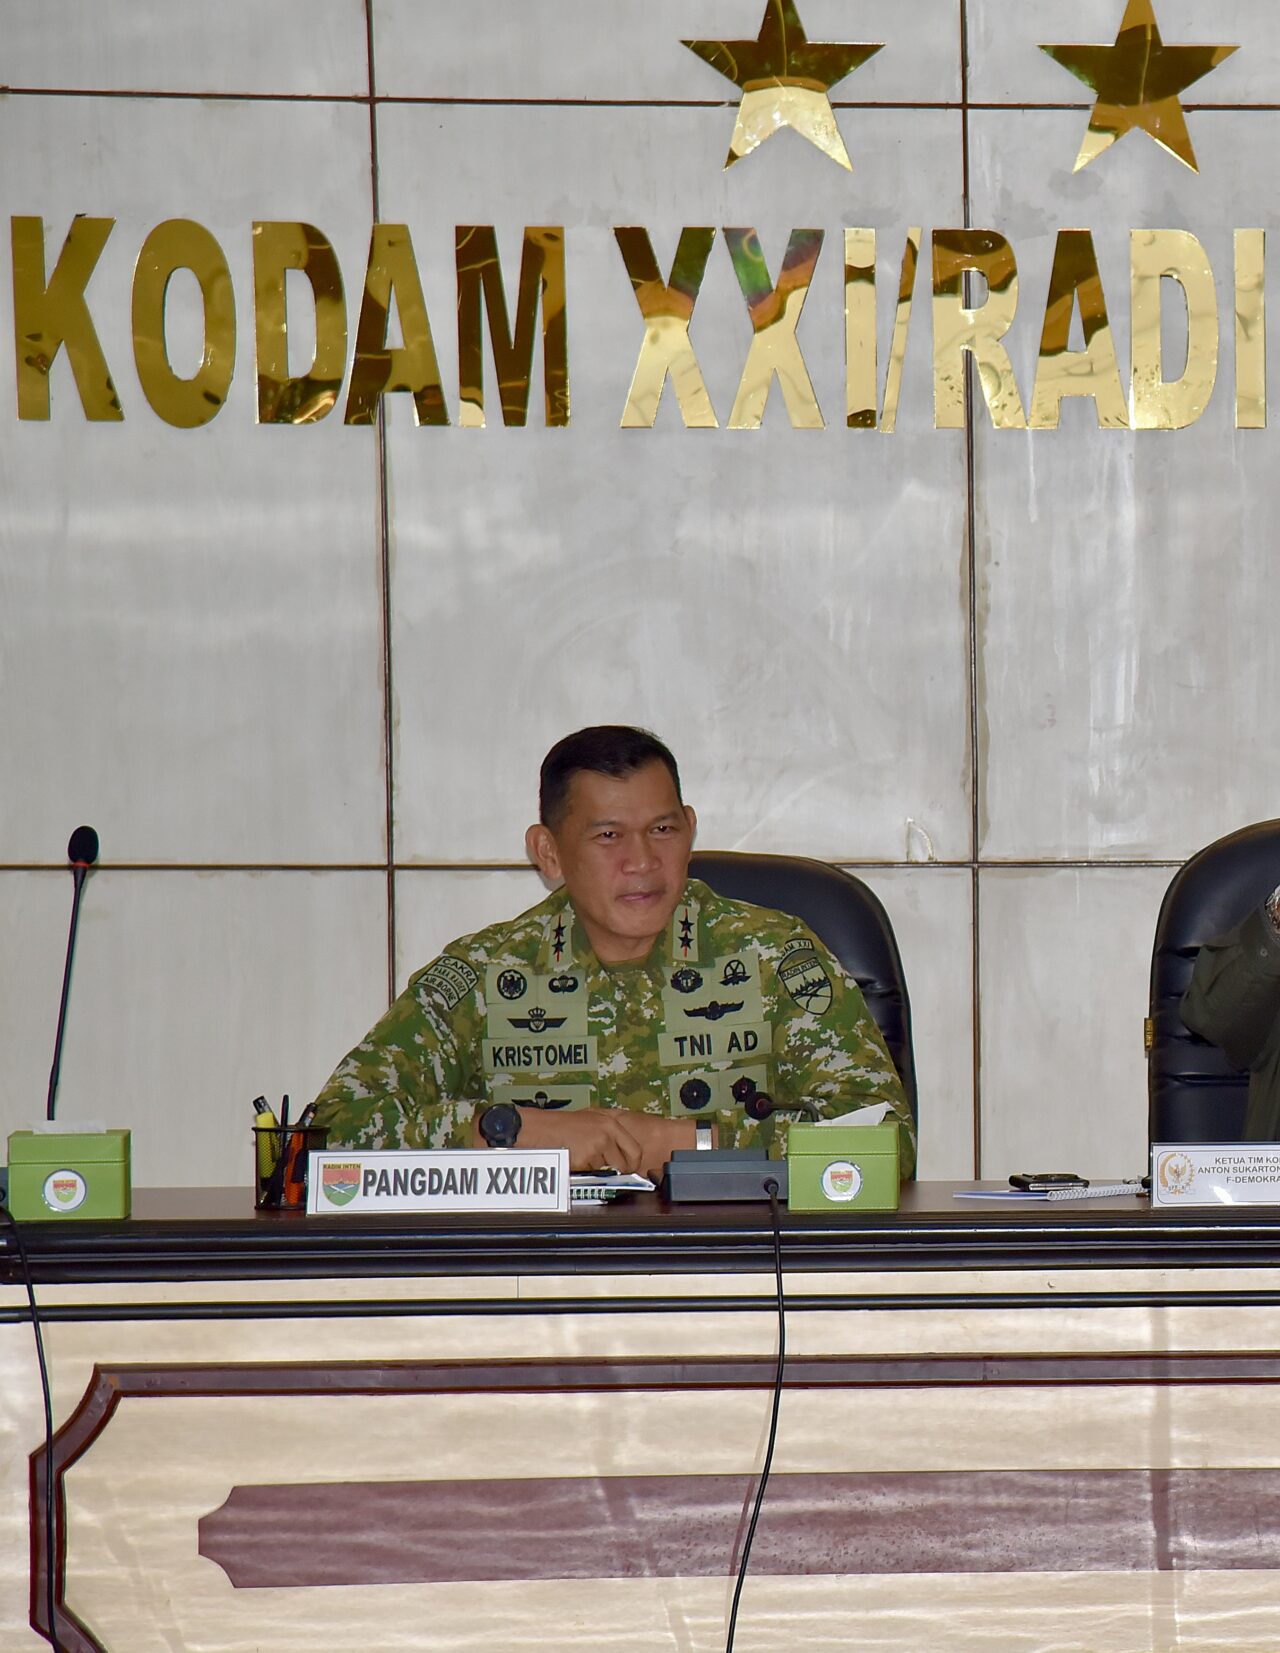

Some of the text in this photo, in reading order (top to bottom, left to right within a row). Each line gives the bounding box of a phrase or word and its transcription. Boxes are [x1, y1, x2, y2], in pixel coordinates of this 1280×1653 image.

[11, 214, 569, 428] KODAM
[442, 958, 476, 985] CAKRA
[437, 980, 457, 1001] BORNE
[492, 1043, 588, 1067] KRISTOMEI
[674, 1030, 758, 1057] TNI AD
[1198, 1166, 1230, 1174] ANTON
[1215, 1157, 1245, 1165] KETUA
[362, 1166, 556, 1197] PANGDAM XXI/RI
